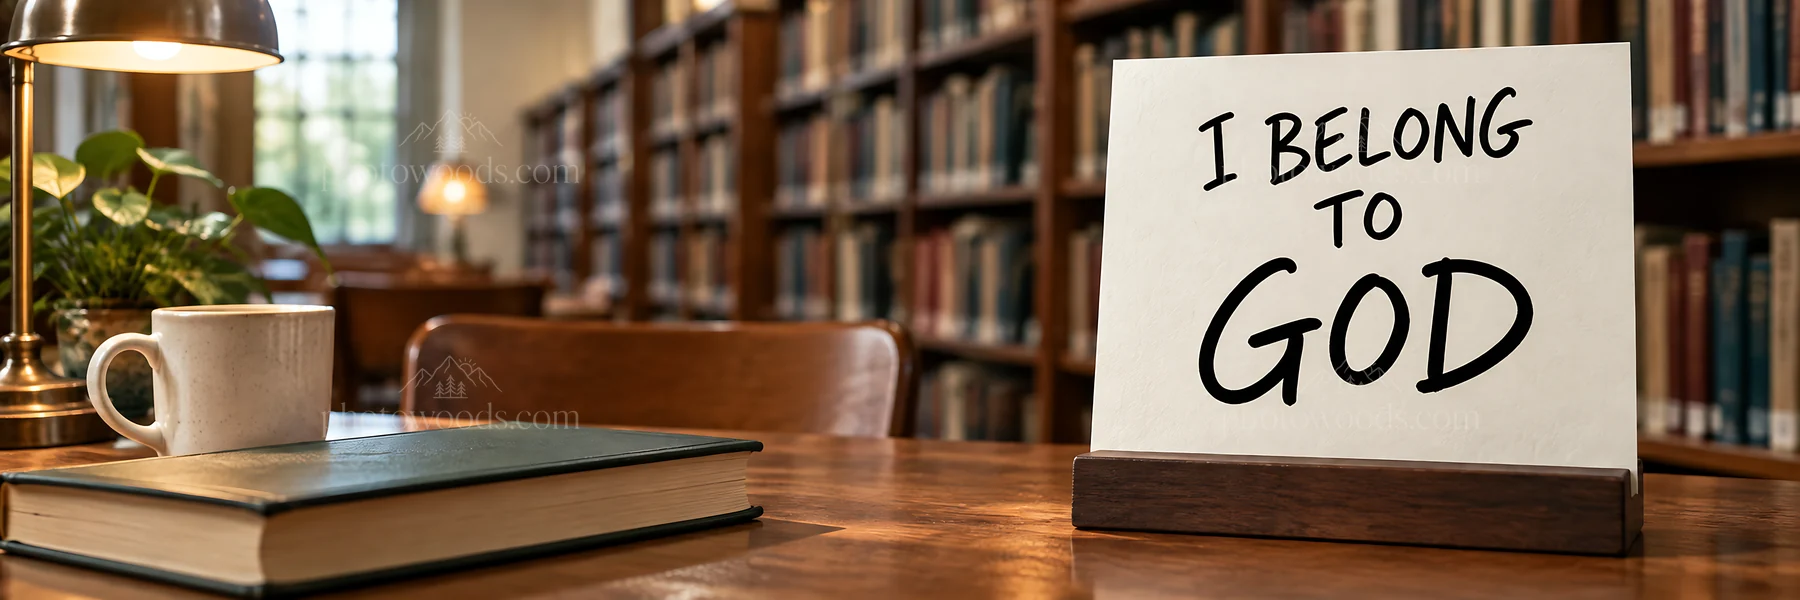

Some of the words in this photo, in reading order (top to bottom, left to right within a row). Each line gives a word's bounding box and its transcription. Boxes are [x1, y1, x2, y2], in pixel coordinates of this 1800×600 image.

[1198, 111, 1238, 192] I
[1264, 86, 1534, 186] BELONG
[1313, 189, 1403, 249] TO
[1198, 256, 1534, 407] GOD
